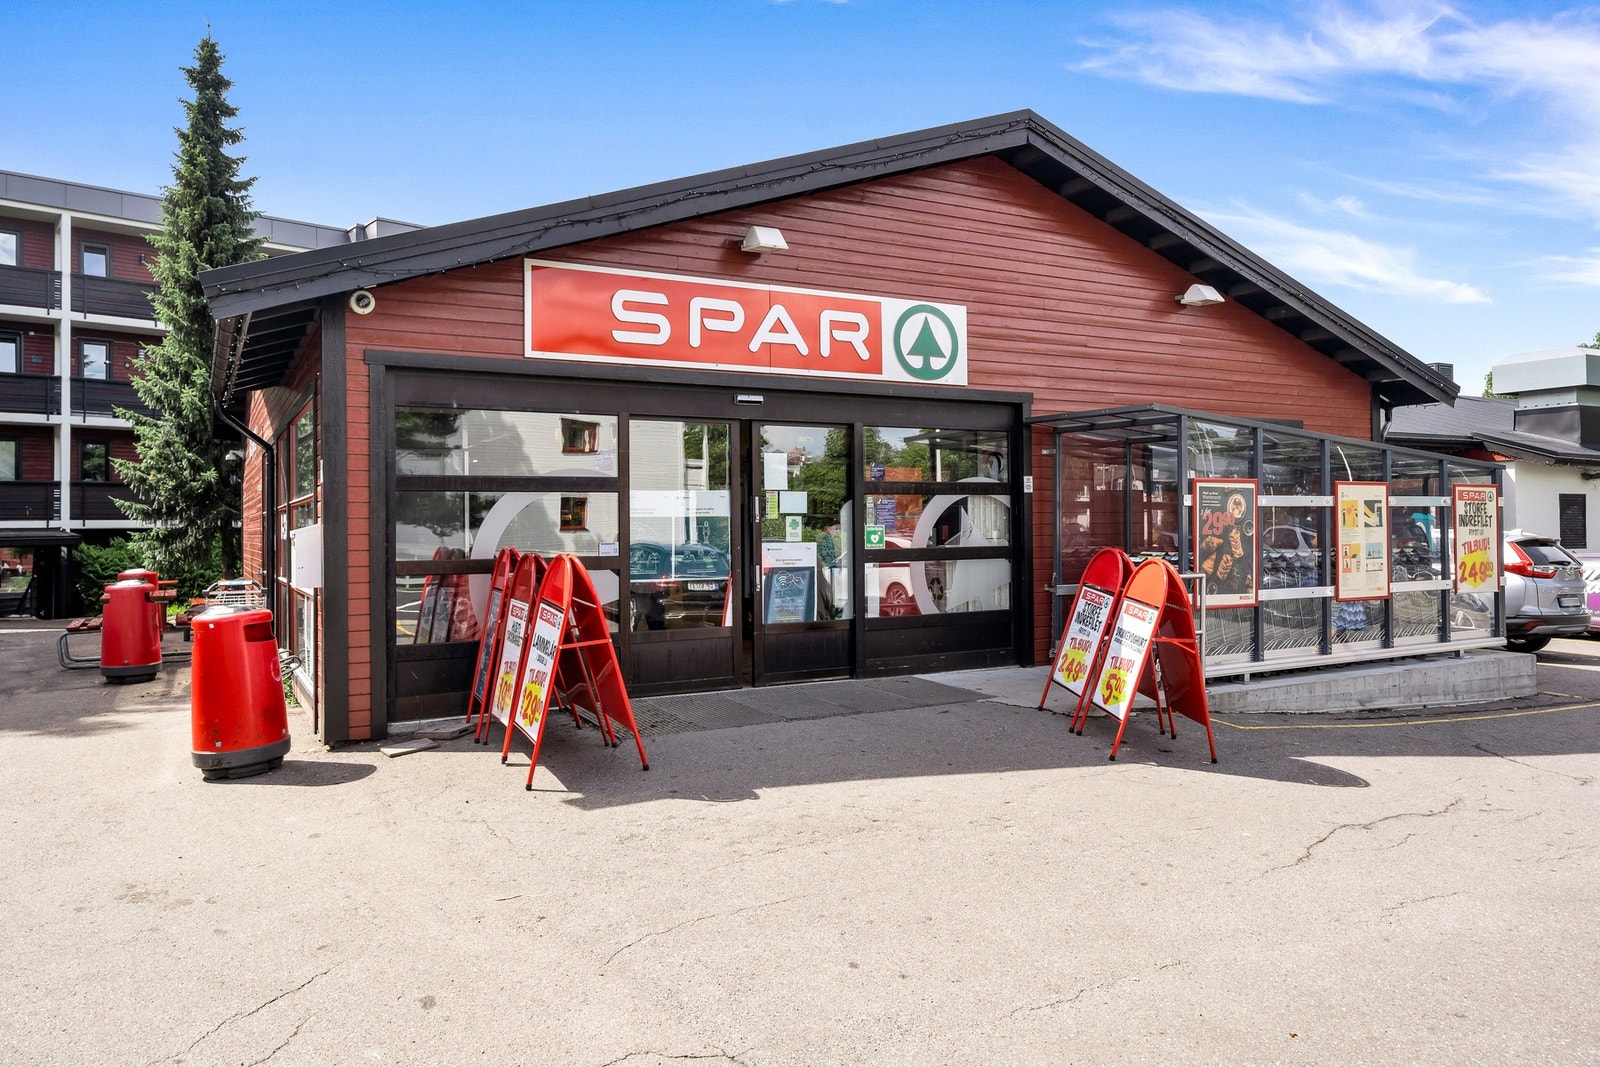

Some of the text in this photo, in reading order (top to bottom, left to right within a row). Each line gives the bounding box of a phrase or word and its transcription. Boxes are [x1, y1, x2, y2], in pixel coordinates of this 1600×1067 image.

[611, 288, 871, 361] SPAR
[1462, 491, 1486, 500] SPAR
[1464, 501, 1487, 515] STORFE
[1459, 514, 1493, 527] INDREFILET
[1461, 537, 1490, 555] TILBUD!
[1086, 592, 1104, 605] SPAR
[542, 609, 558, 626] SPAR
[1128, 606, 1148, 620] SPAR
[1070, 636, 1093, 654] TILBUD!
[1110, 655, 1136, 673] TILBUD!
